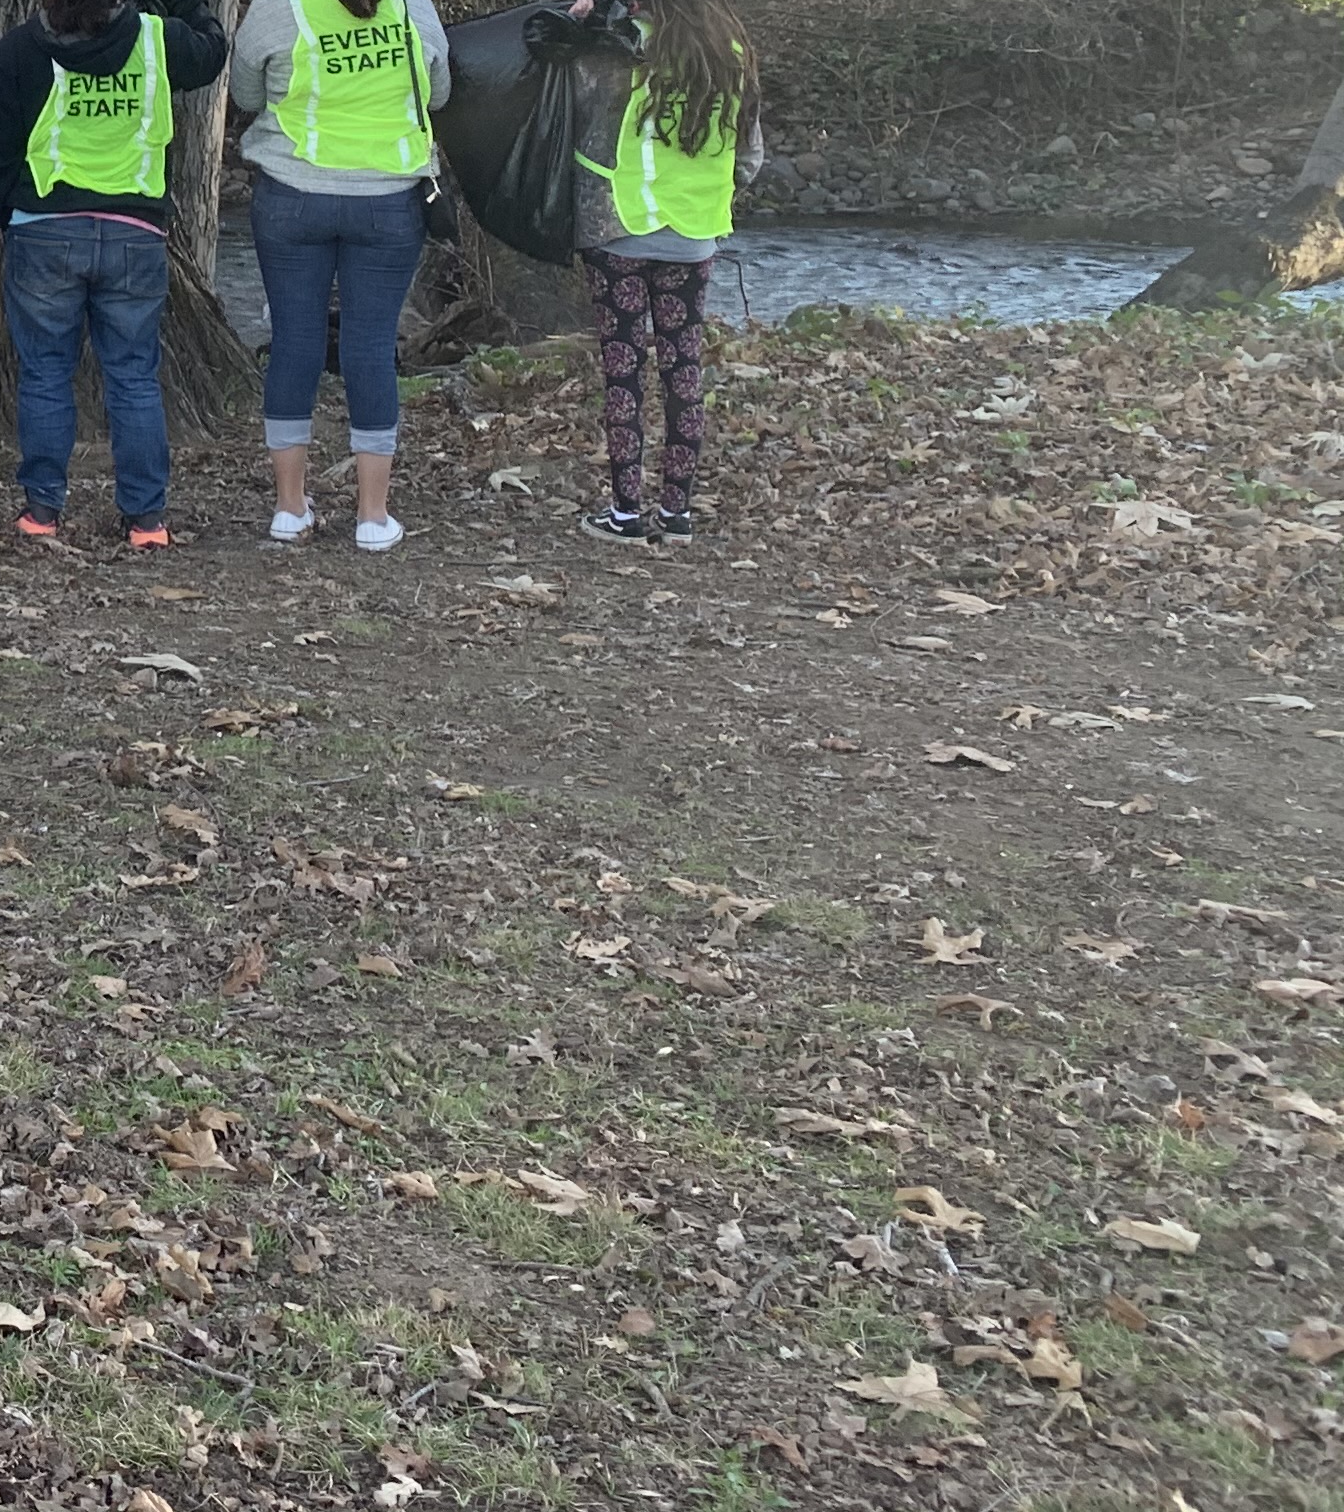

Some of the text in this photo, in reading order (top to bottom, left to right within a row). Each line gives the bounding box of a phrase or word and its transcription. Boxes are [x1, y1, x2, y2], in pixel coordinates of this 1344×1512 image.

[318, 23, 403, 54] EVENT
[326, 48, 405, 75] STAFF
[68, 73, 143, 96] EVENT
[67, 98, 140, 118] STAFF
